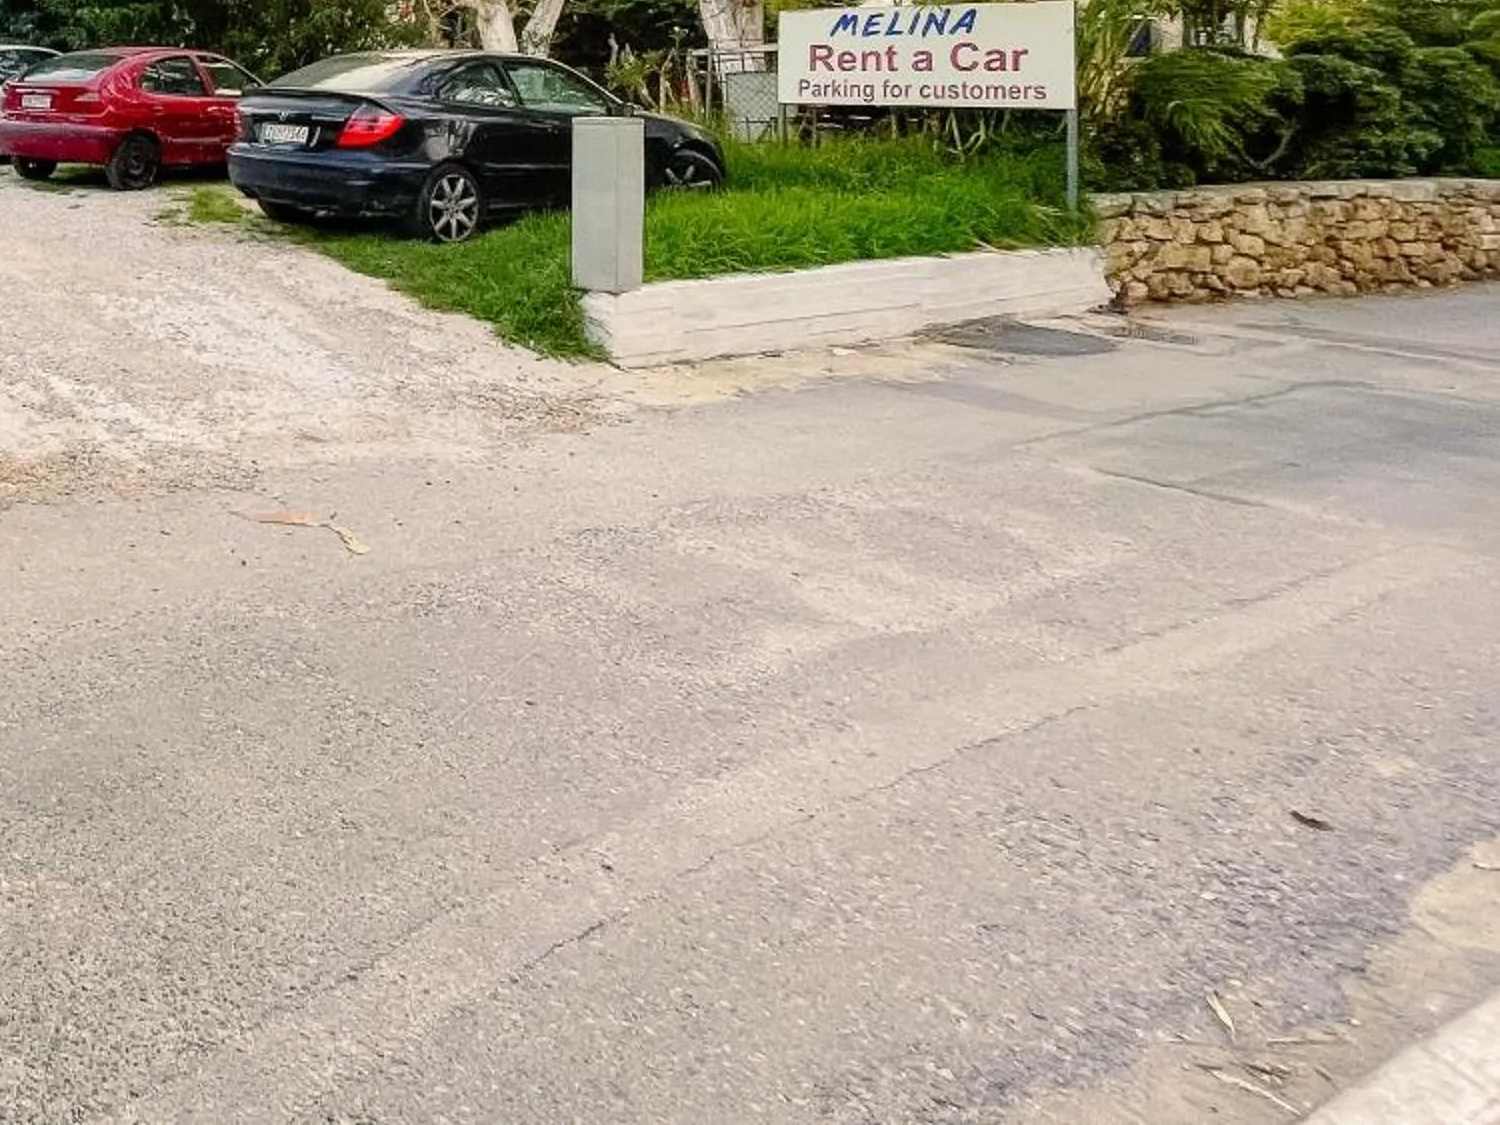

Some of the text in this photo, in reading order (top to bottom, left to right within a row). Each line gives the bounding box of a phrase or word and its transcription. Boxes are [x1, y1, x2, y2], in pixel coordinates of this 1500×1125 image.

[829, 8, 978, 37] MELINA
[808, 42, 1028, 72] Rent a Car
[798, 79, 1047, 103] Parking for customers
